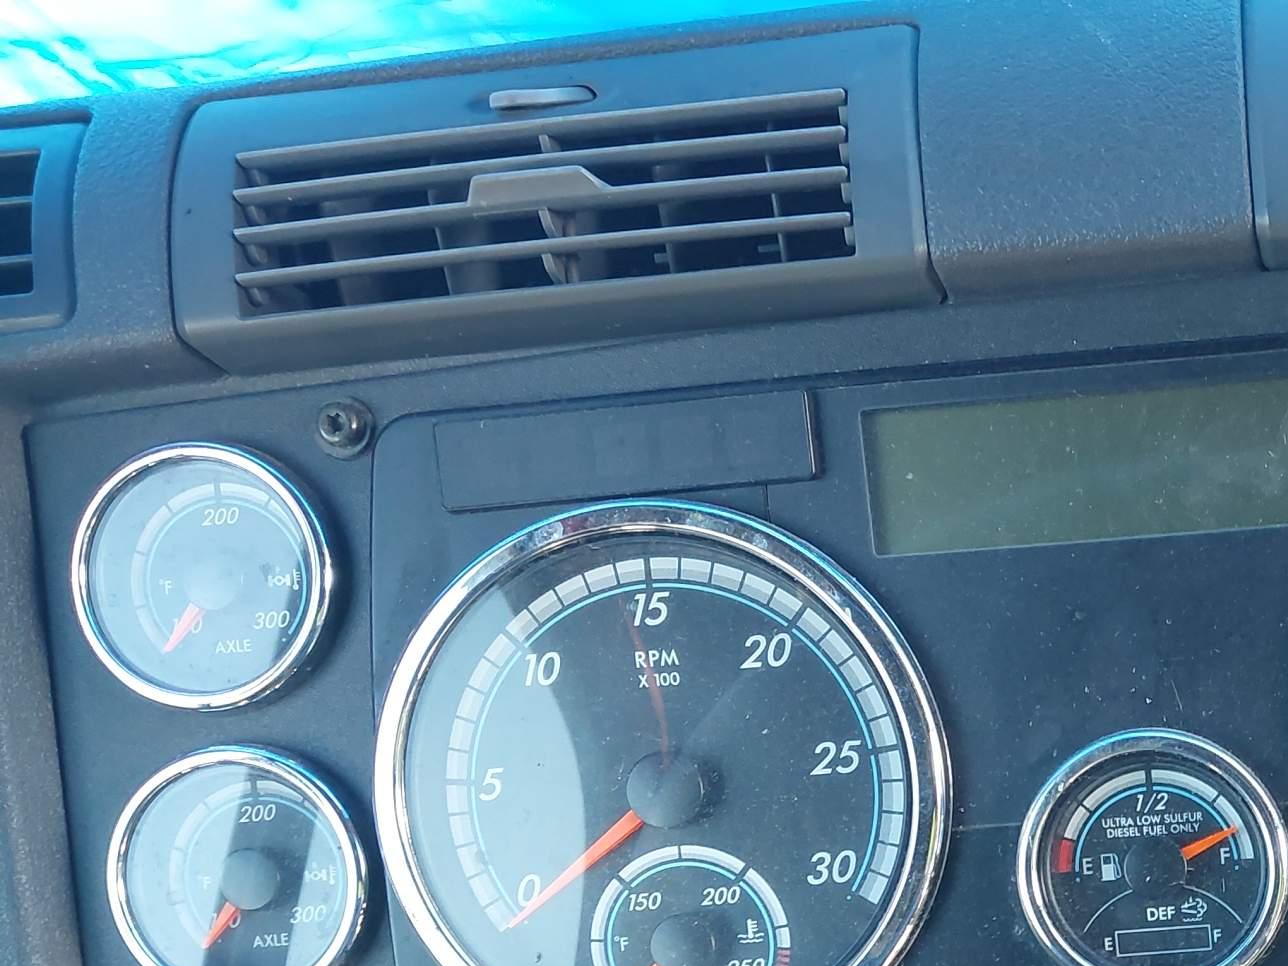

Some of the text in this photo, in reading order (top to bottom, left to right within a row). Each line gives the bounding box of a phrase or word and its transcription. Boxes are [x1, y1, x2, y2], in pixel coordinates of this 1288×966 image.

[202, 507, 239, 527] 200
[632, 591, 671, 627] 15
[254, 611, 290, 629] 300
[215, 639, 252, 654] AXLE
[740, 634, 792, 669] 20
[634, 648, 681, 669] RPM
[524, 651, 560, 687] 10
[637, 671, 681, 689] X 100
[810, 740, 861, 776] 25
[479, 768, 504, 801] 5
[239, 804, 276, 823] 200
[1135, 794, 1168, 814] 1/2
[1102, 811, 1203, 828] ULTRA LOW SULFUR
[1107, 822, 1200, 838] DIESEL FUEL ONLY
[1220, 848, 1230, 864] F
[806, 850, 856, 885] 30
[1082, 858, 1094, 874] E
[517, 872, 542, 909] 0
[701, 886, 740, 907] 200
[628, 891, 662, 912] 150
[290, 905, 327, 924] 300
[1147, 906, 1175, 922] DEF
[253, 932, 289, 948] AXLE
[1104, 937, 1114, 951] E
[1214, 929, 1222, 943] F
